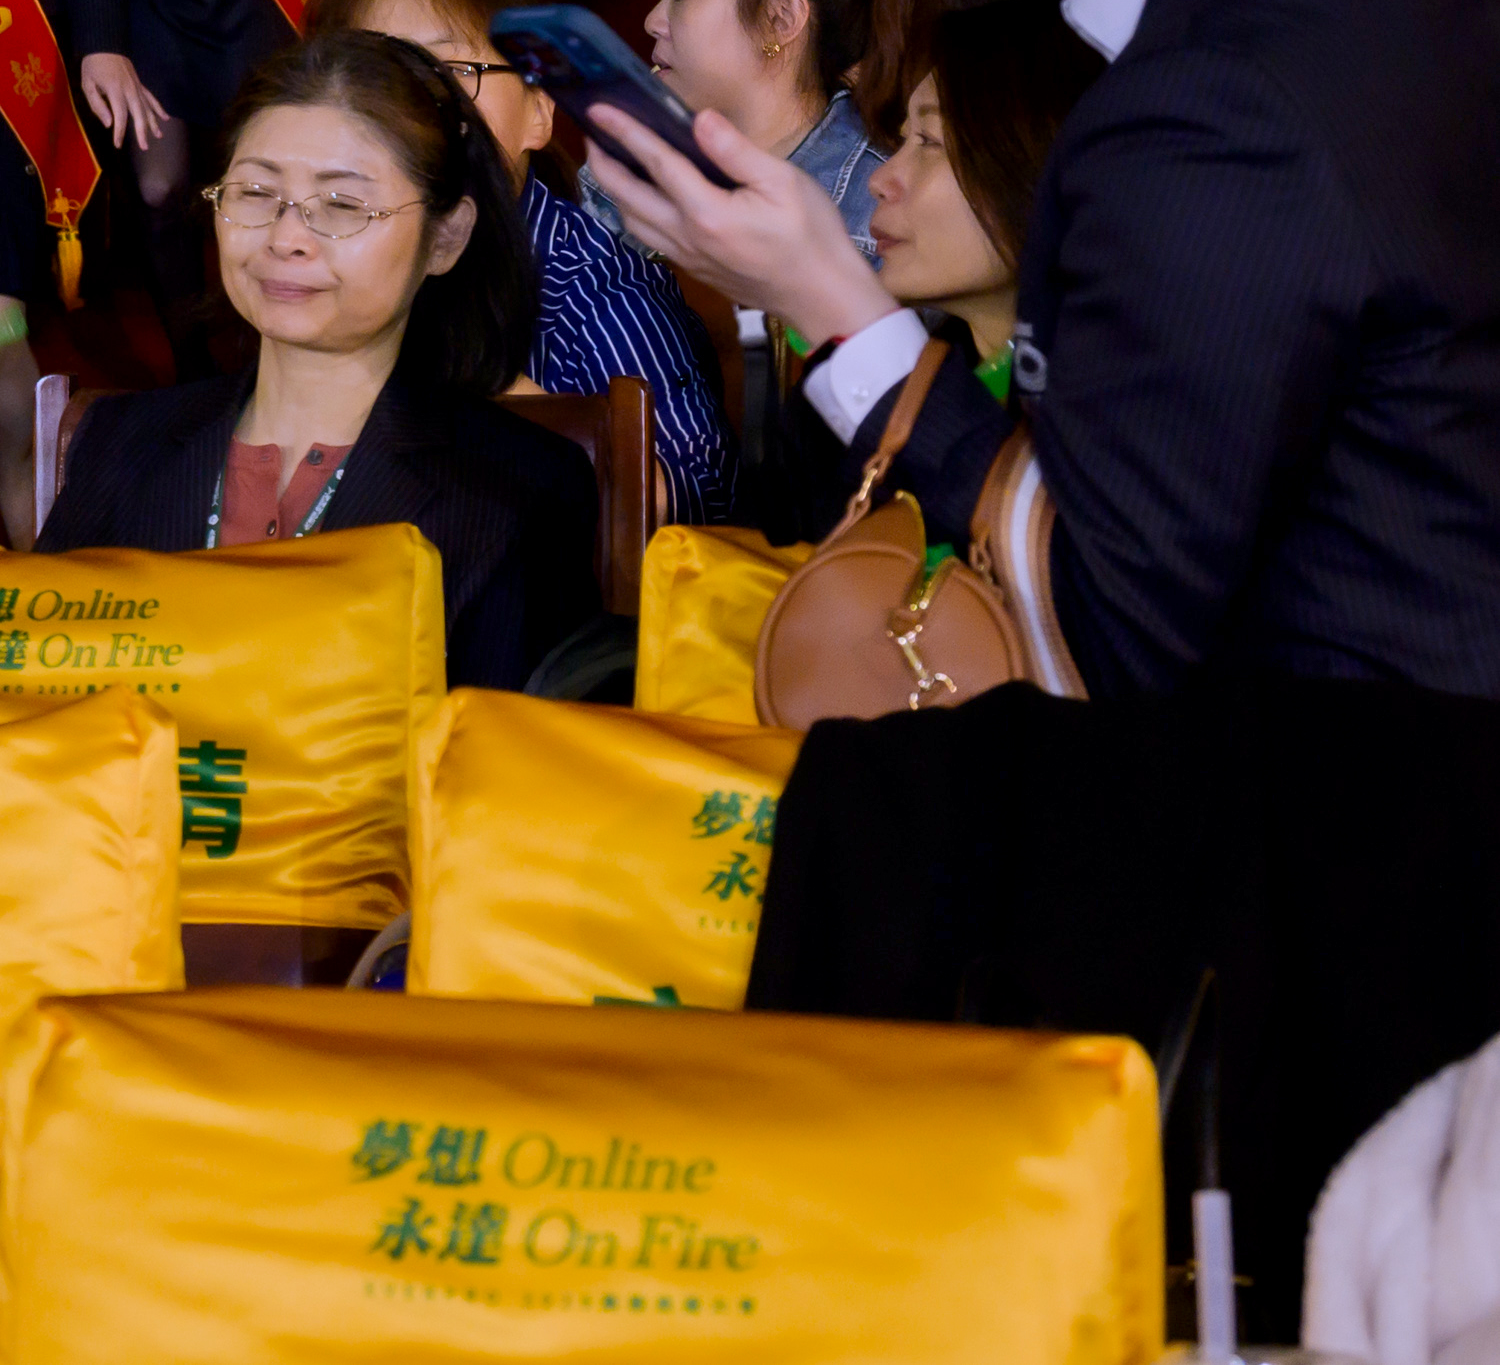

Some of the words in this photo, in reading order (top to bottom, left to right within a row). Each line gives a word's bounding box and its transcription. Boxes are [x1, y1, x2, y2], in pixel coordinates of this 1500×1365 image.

[27, 588, 160, 622] Online
[38, 633, 98, 669] On
[104, 632, 185, 669] Fire
[702, 849, 765, 905] 永
[502, 1130, 719, 1195] Online
[523, 1205, 620, 1269] On
[629, 1210, 763, 1273] Fire
